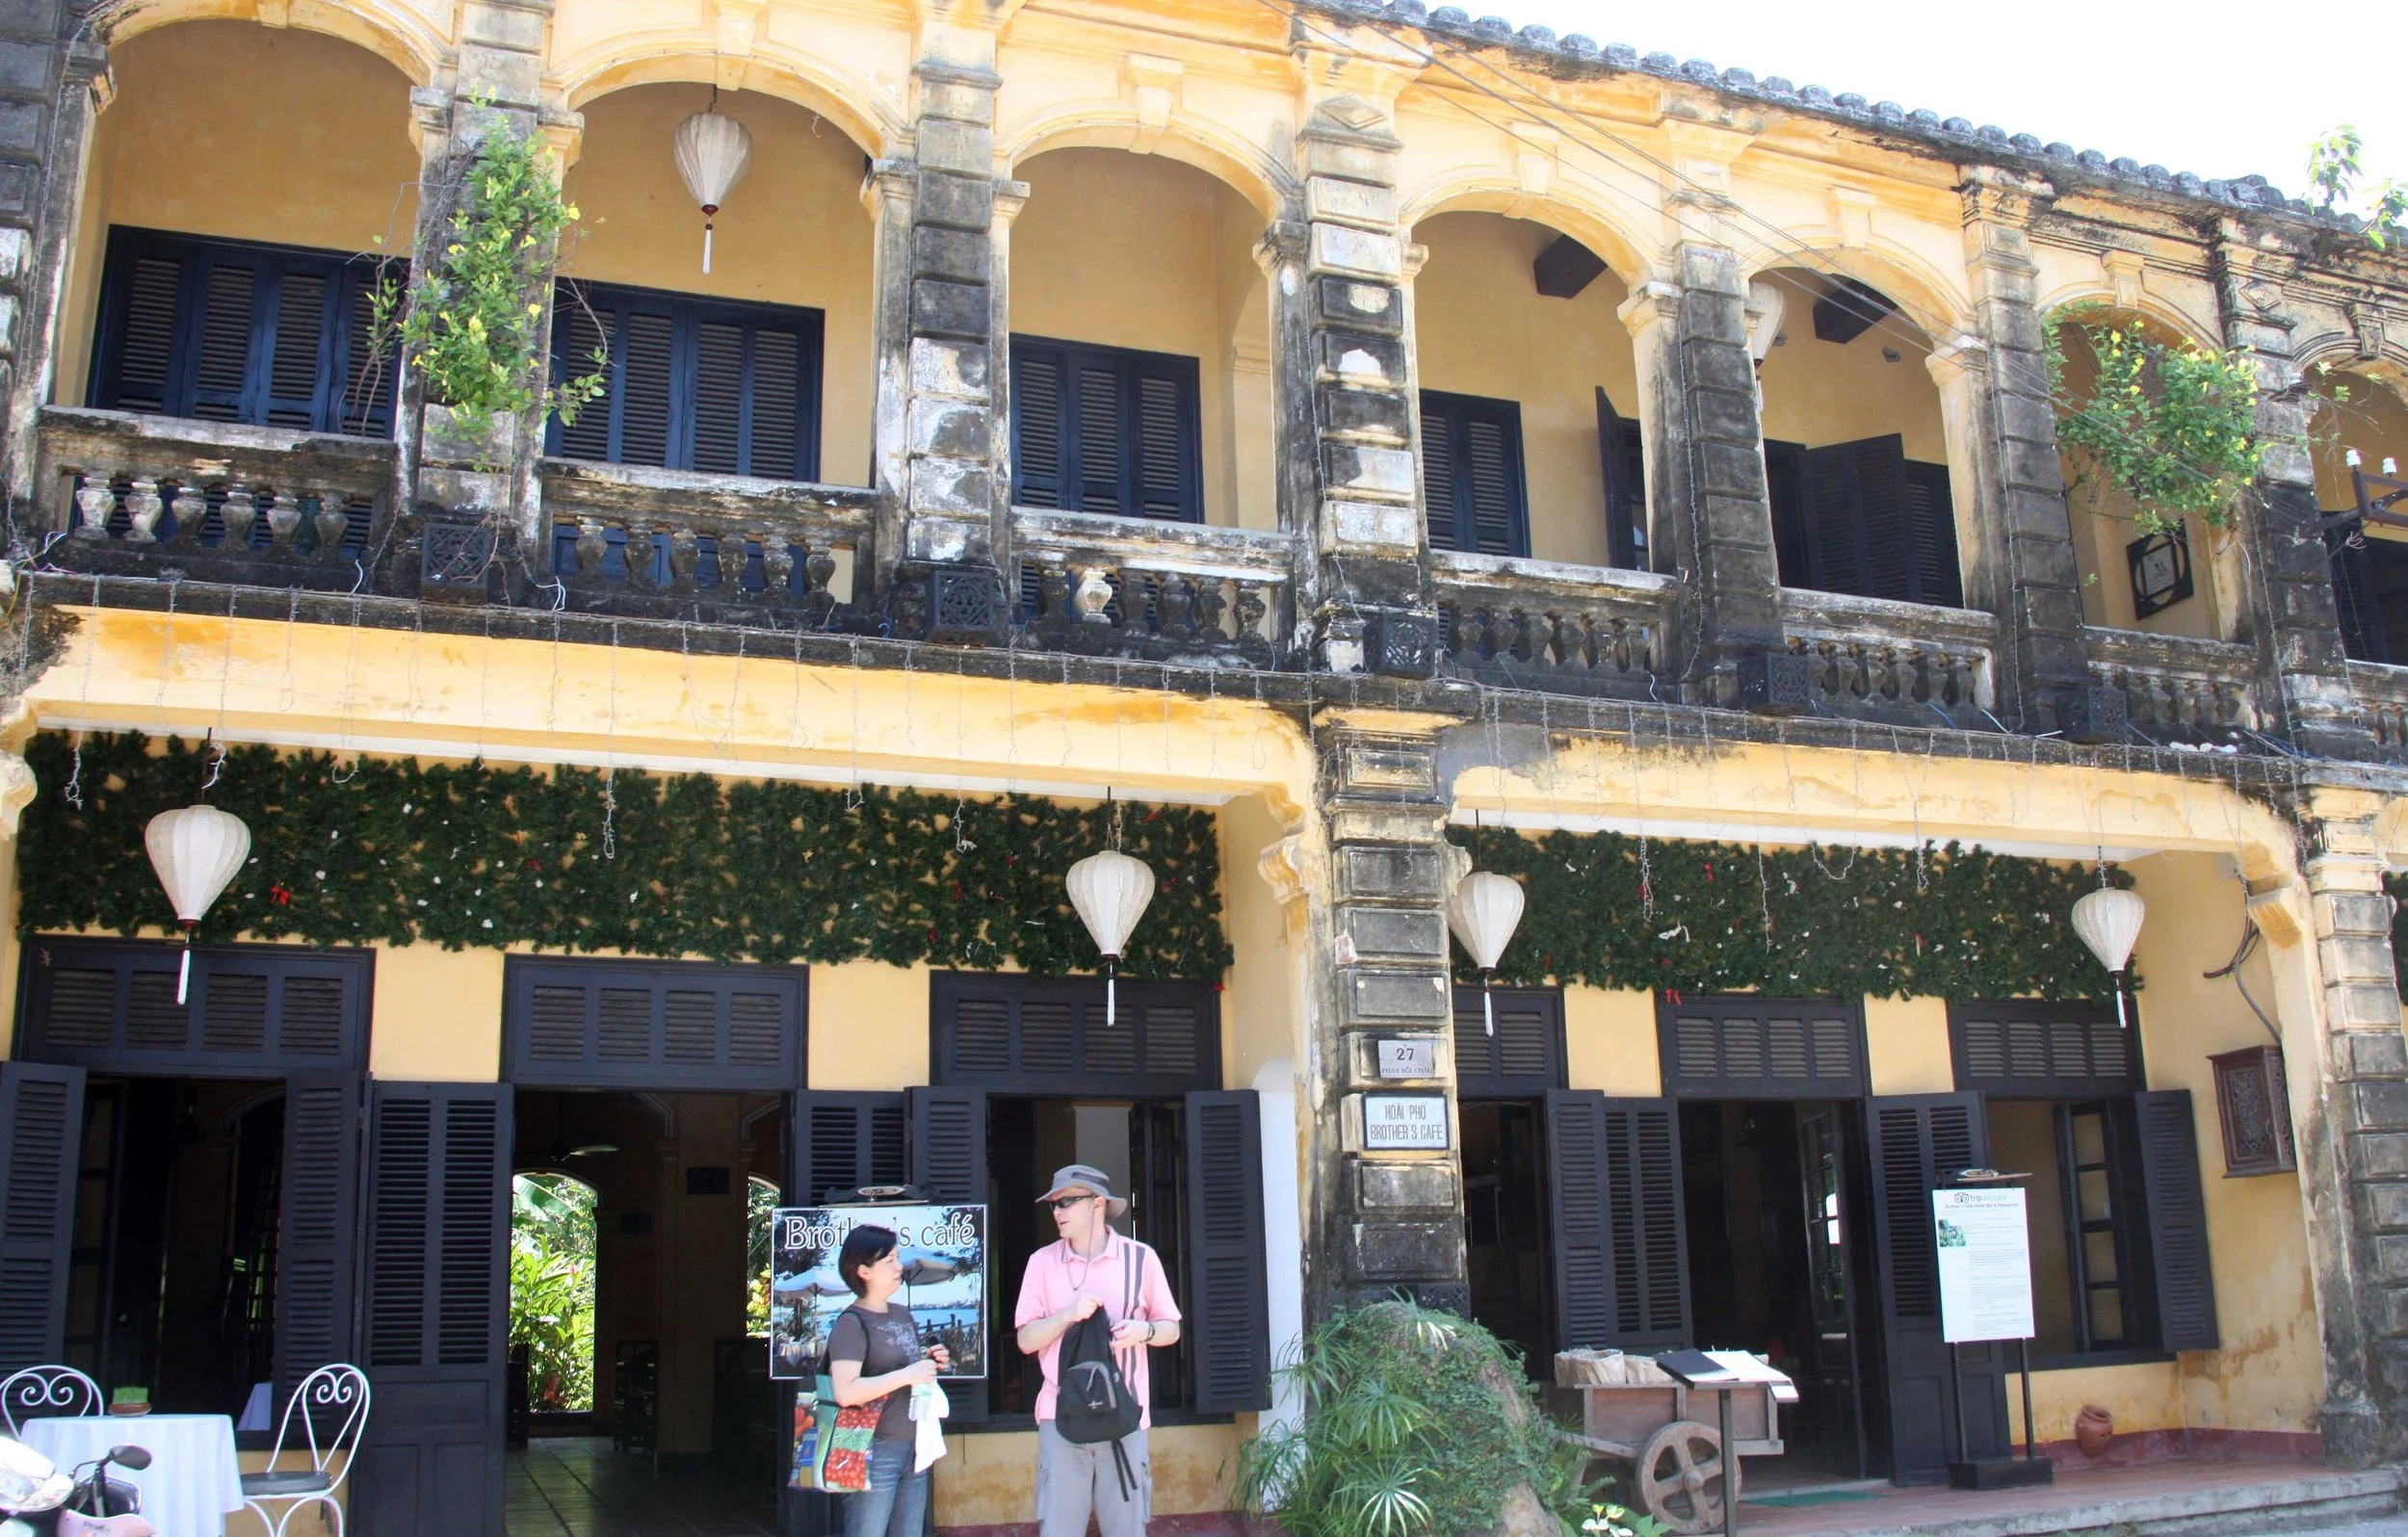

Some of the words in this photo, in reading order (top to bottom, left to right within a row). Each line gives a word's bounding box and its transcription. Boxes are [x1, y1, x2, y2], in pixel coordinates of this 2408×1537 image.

[1396, 1048, 1414, 1060] 27
[1384, 1103, 1404, 1120] HOÀI
[1409, 1102, 1427, 1119] PHỐ
[1370, 1123, 1418, 1140] BROTHER'S
[1420, 1121, 1443, 1140] CAFÉ
[921, 1212, 976, 1247] café
